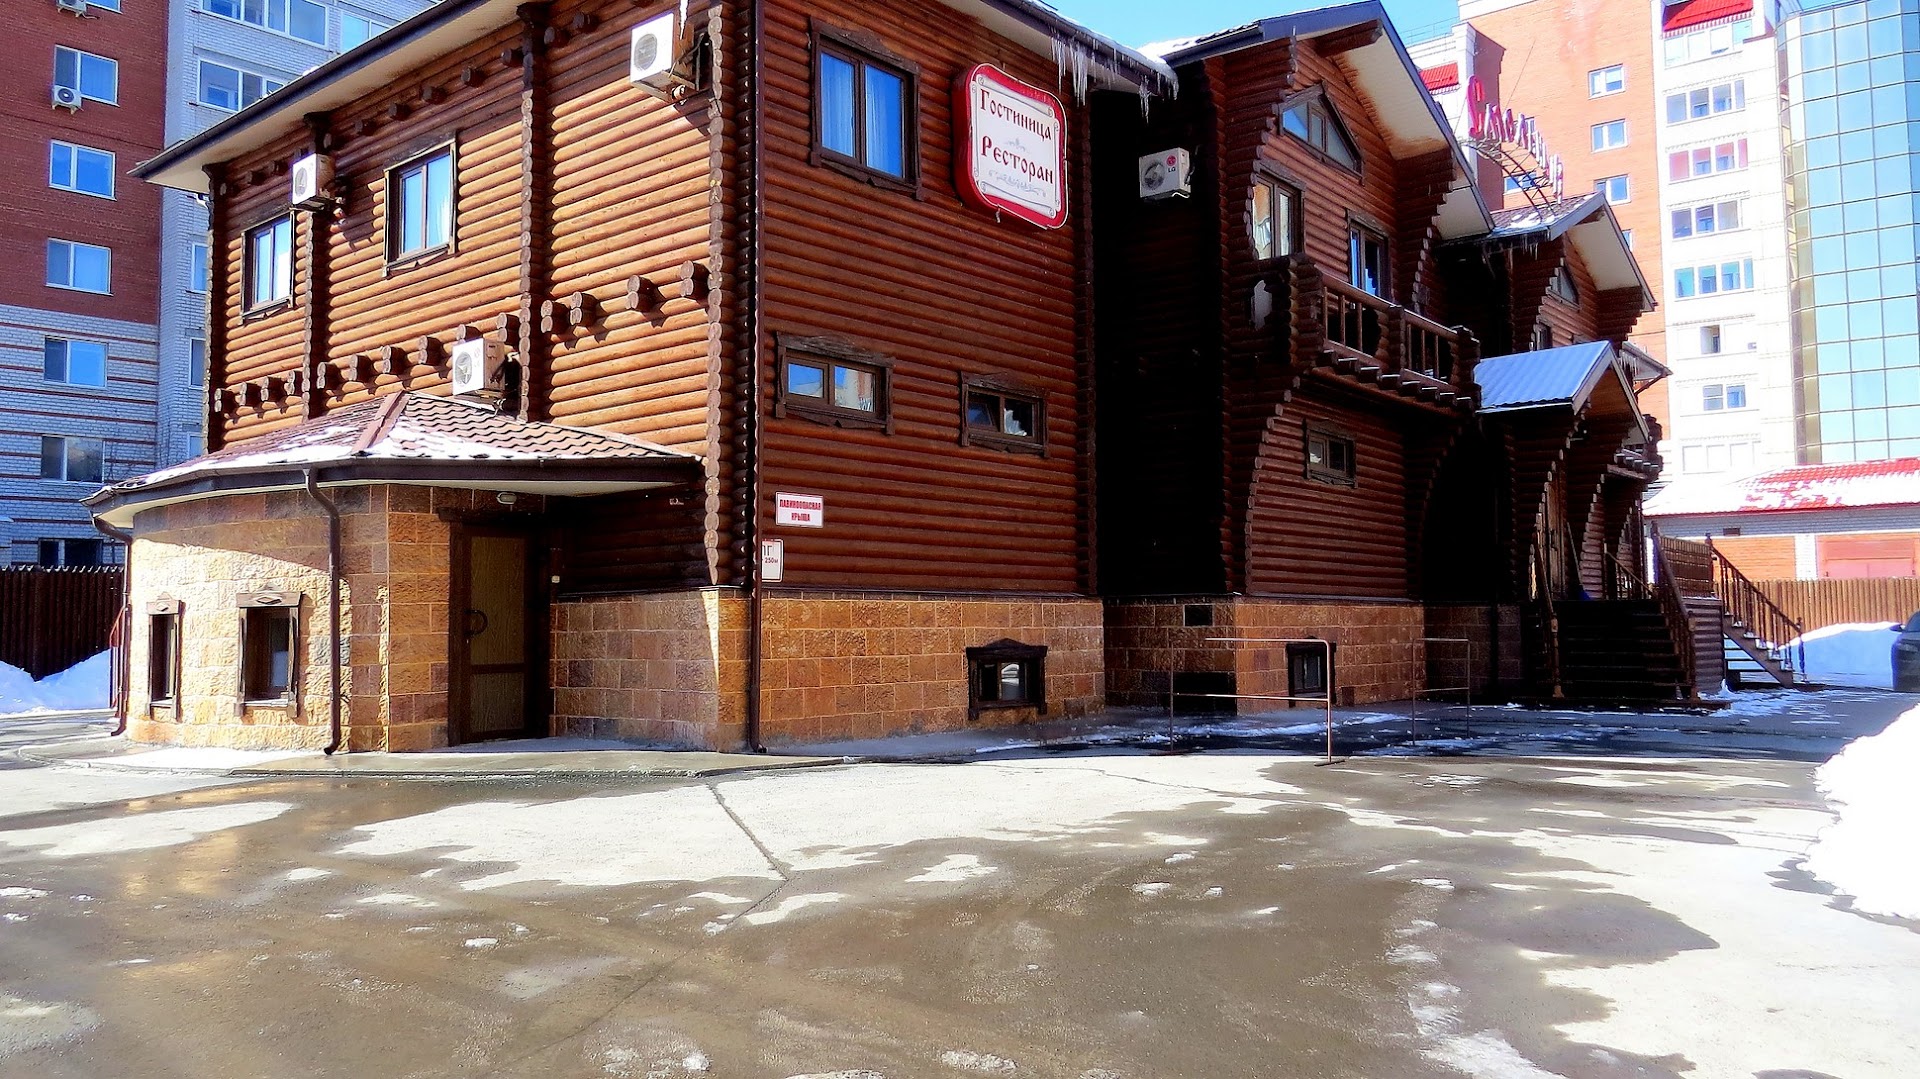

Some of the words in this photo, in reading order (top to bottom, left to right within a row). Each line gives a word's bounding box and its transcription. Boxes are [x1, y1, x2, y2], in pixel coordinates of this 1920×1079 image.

[980, 89, 1052, 142] Гостиница
[981, 135, 1053, 184] Ресторан
[791, 512, 810, 521] КРЫША
